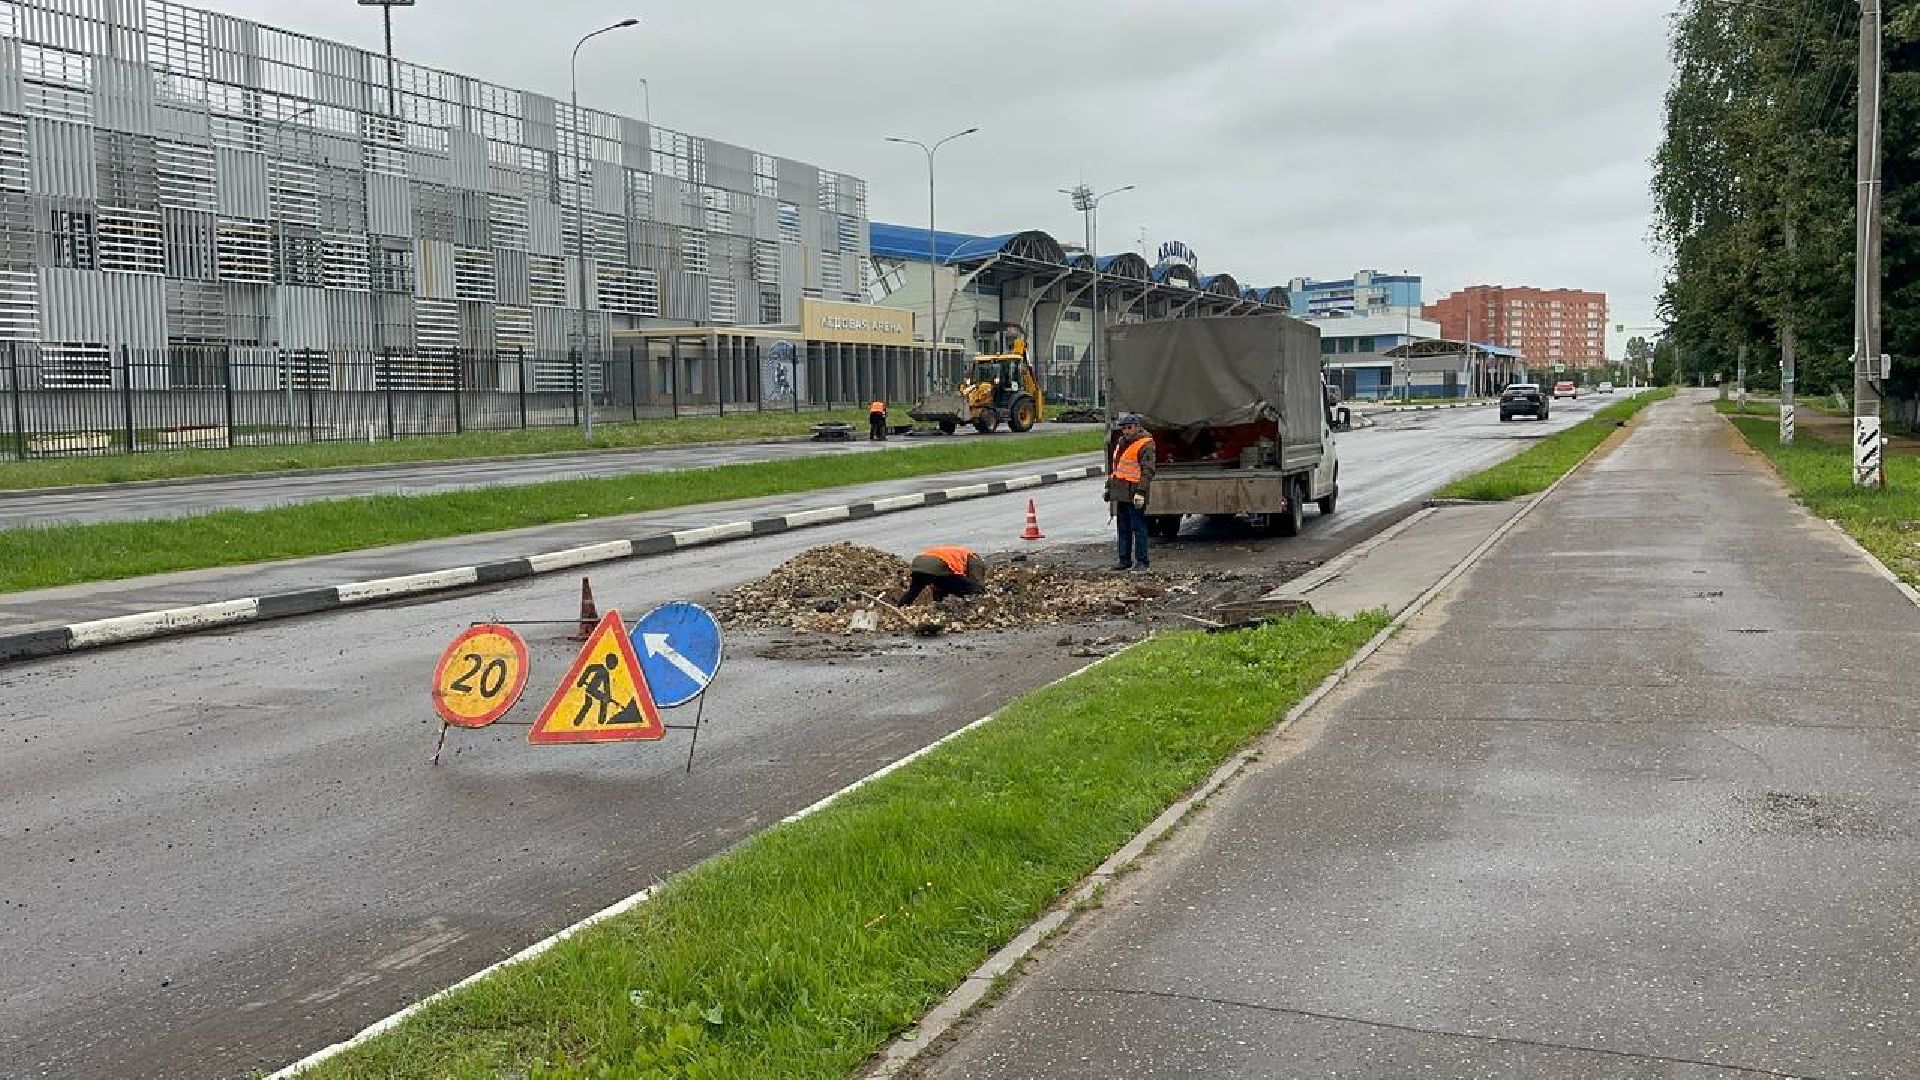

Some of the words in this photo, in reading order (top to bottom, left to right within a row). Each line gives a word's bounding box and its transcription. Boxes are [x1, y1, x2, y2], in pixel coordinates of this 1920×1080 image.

[821, 316, 867, 331] ЛЕДОВАЯ
[873, 320, 902, 334] АРЕНА
[450, 653, 506, 698] 20
